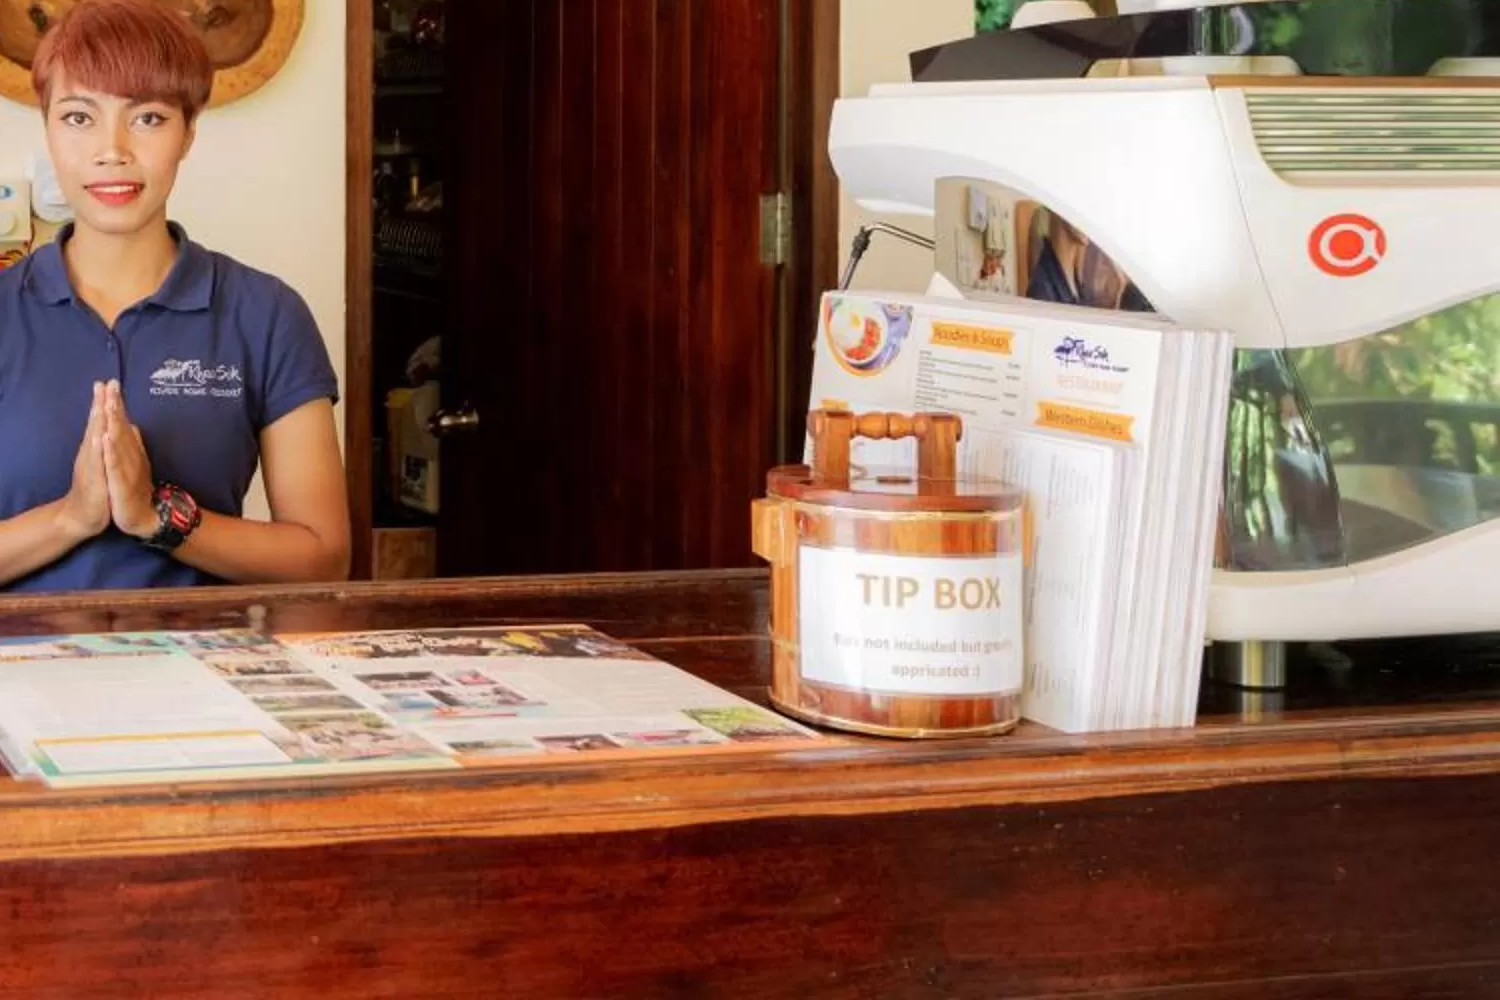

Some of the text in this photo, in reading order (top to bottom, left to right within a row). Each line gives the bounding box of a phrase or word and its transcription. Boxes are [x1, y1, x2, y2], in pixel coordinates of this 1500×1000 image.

[855, 572, 1002, 611] TIP BOX
[864, 636, 890, 649] not
[894, 636, 957, 654] included
[961, 638, 981, 654] but
